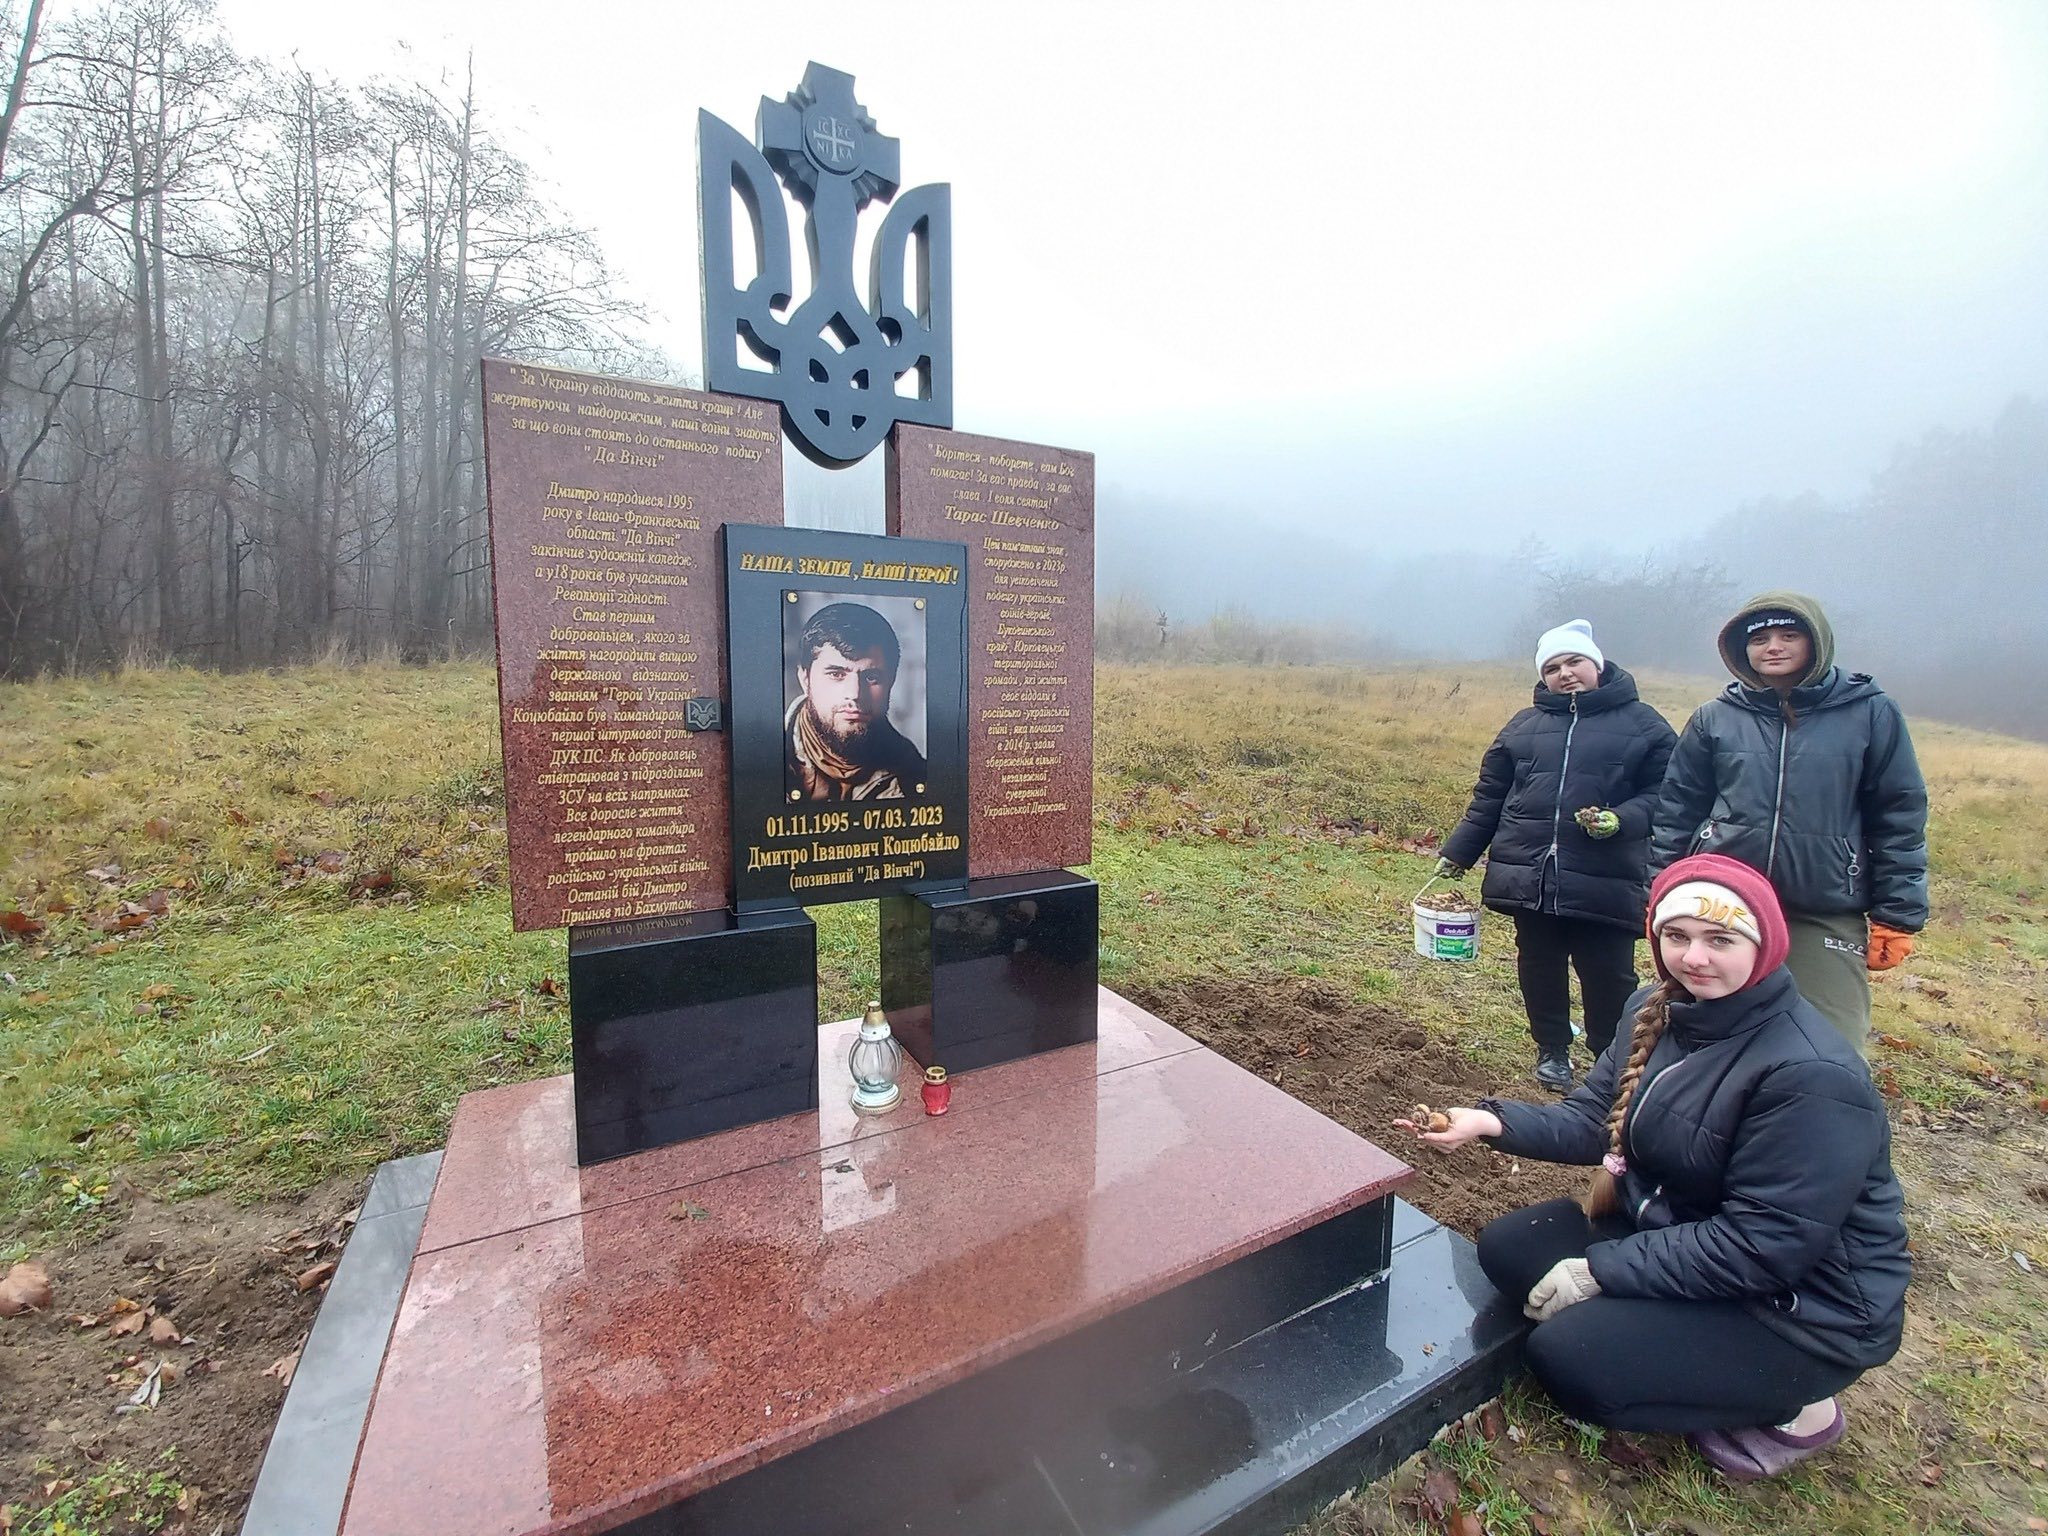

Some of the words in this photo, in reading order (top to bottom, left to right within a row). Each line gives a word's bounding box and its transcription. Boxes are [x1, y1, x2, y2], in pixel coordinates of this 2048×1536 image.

[540, 372, 590, 397] Україну
[592, 381, 651, 403] віддають
[653, 394, 699, 410] життя
[744, 404, 764, 421] Але
[490, 391, 571, 413] жертвуючи
[701, 421, 731, 437] воїни
[511, 417, 527, 430] за
[530, 420, 550, 435] що
[552, 423, 582, 437] вони
[584, 427, 632, 443] стоять
[635, 431, 649, 447] до
[652, 437, 719, 455] останнього
[976, 469, 988, 483] За
[547, 481, 600, 505] Дмитро
[603, 488, 664, 508] народився
[667, 494, 694, 510] 1995
[542, 505, 572, 523] року
[575, 509, 583, 520] в
[944, 504, 987, 525] Тарас
[991, 510, 1060, 530] Шевченко
[530, 544, 585, 560] закінчив
[587, 546, 646, 564] художній
[569, 567, 603, 584] років
[605, 567, 626, 584] був
[628, 571, 689, 587] учасником
[740, 552, 794, 574] НАША
[861, 558, 907, 581] НАШІ
[554, 585, 616, 606] Революції
[572, 606, 606, 622] Став
[609, 611, 656, 627] першим
[643, 632, 675, 644] якого
[677, 632, 691, 644] за
[536, 648, 586, 662] життя
[589, 648, 656, 665] нагородили
[659, 652, 698, 666] вищою
[550, 665, 622, 684] державною
[548, 689, 599, 702] званням
[511, 707, 584, 726] Коцюбайло
[587, 707, 607, 725] був
[613, 706, 684, 724] командиром
[551, 727, 597, 745] першої
[598, 726, 663, 744] штурмової
[549, 749, 581, 768] ДУК
[608, 748, 625, 763] Як
[628, 747, 698, 765] доброволець
[538, 770, 620, 787] співпрацював
[622, 771, 629, 781] з
[631, 764, 704, 783] підрозділами
[557, 788, 587, 805] ЗСУ
[588, 791, 603, 803] на
[605, 788, 629, 802] всіх
[565, 807, 588, 823] Все
[590, 806, 637, 824] доросле
[639, 804, 684, 818] життя
[766, 811, 850, 838] 01.11.1995
[553, 827, 633, 845] легендарного
[635, 821, 696, 838] командира
[564, 847, 617, 866] пройшло
[619, 847, 634, 859] на
[636, 841, 688, 861] фронтах
[747, 845, 808, 872] Дмитро
[811, 839, 880, 863] Іванович
[882, 832, 960, 857] Коцюбайло
[546, 868, 606, 889] російсько
[789, 868, 855, 892] (позивний
[857, 864, 880, 883] "Да
[883, 859, 926, 881] Вінчі")
[568, 884, 619, 904] Останій
[621, 883, 640, 899] бій
[641, 880, 688, 899] Дмитро
[560, 906, 612, 927] Прийняв
[614, 902, 632, 918] під
